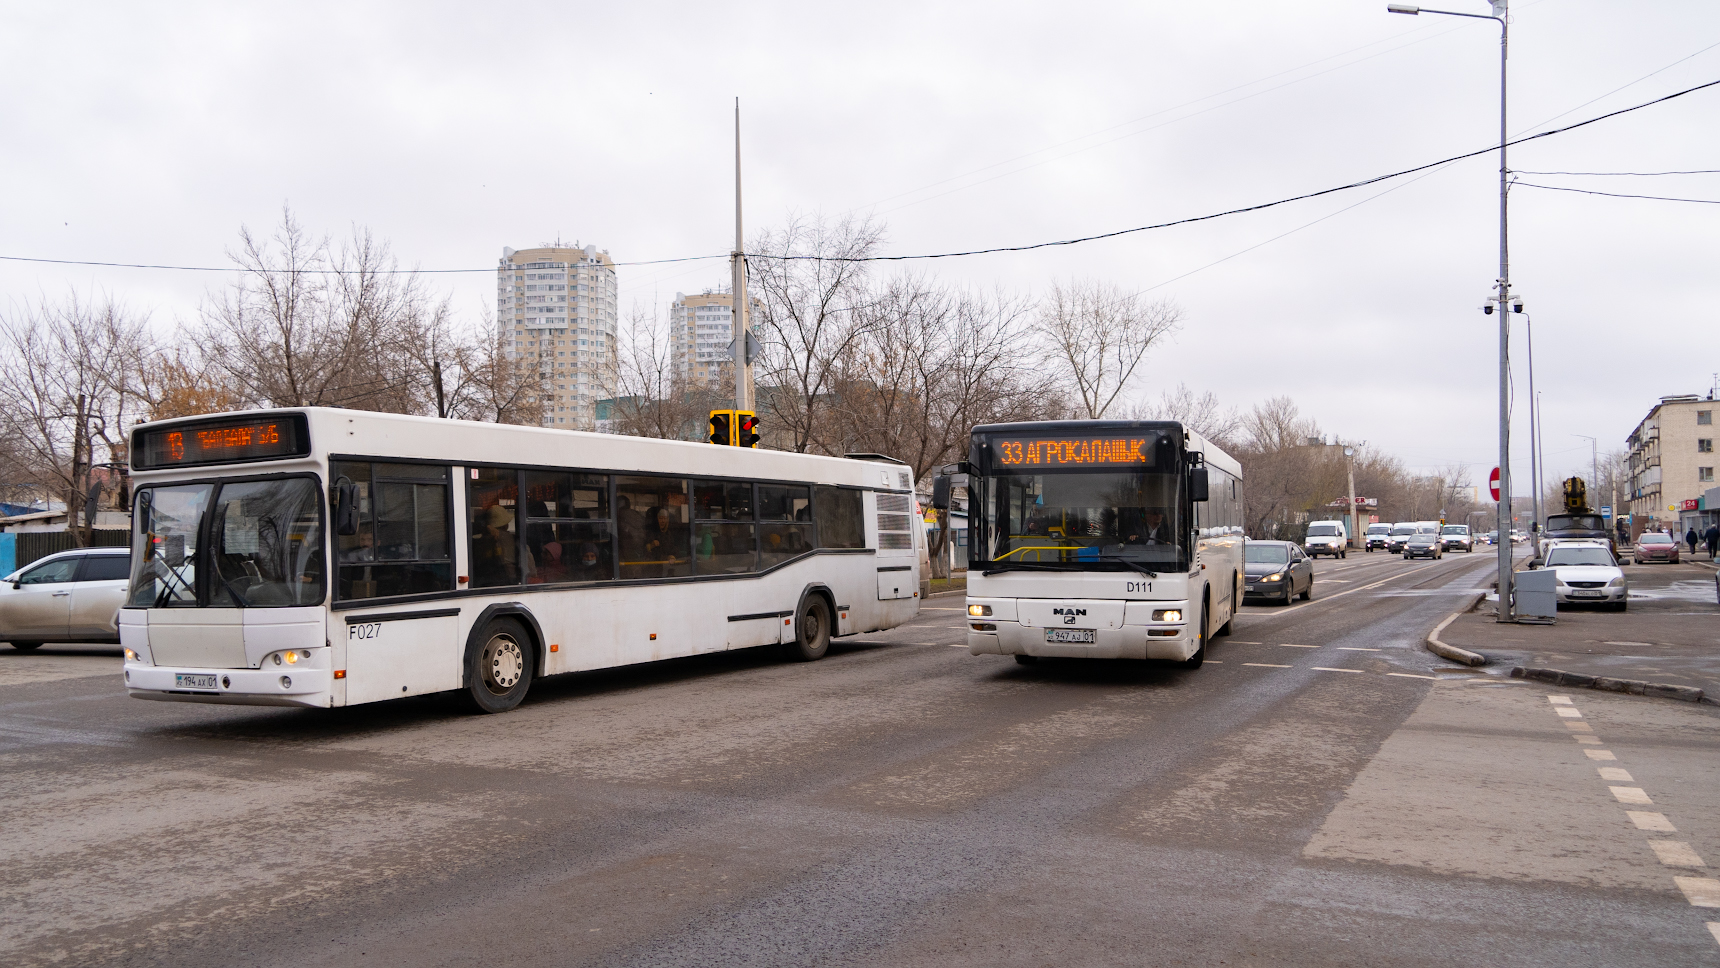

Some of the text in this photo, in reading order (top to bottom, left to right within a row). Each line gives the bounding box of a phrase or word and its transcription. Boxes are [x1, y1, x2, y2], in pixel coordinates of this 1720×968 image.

[1001, 441, 1023, 464] 33
[1127, 581, 1152, 593] D111
[1053, 608, 1087, 616] MAN
[350, 622, 382, 640] F027
[1055, 631, 1070, 640] 947
[1084, 632, 1094, 641] 01
[183, 675, 196, 687] 194
[197, 678, 206, 687] AX
[208, 676, 217, 687] 01
